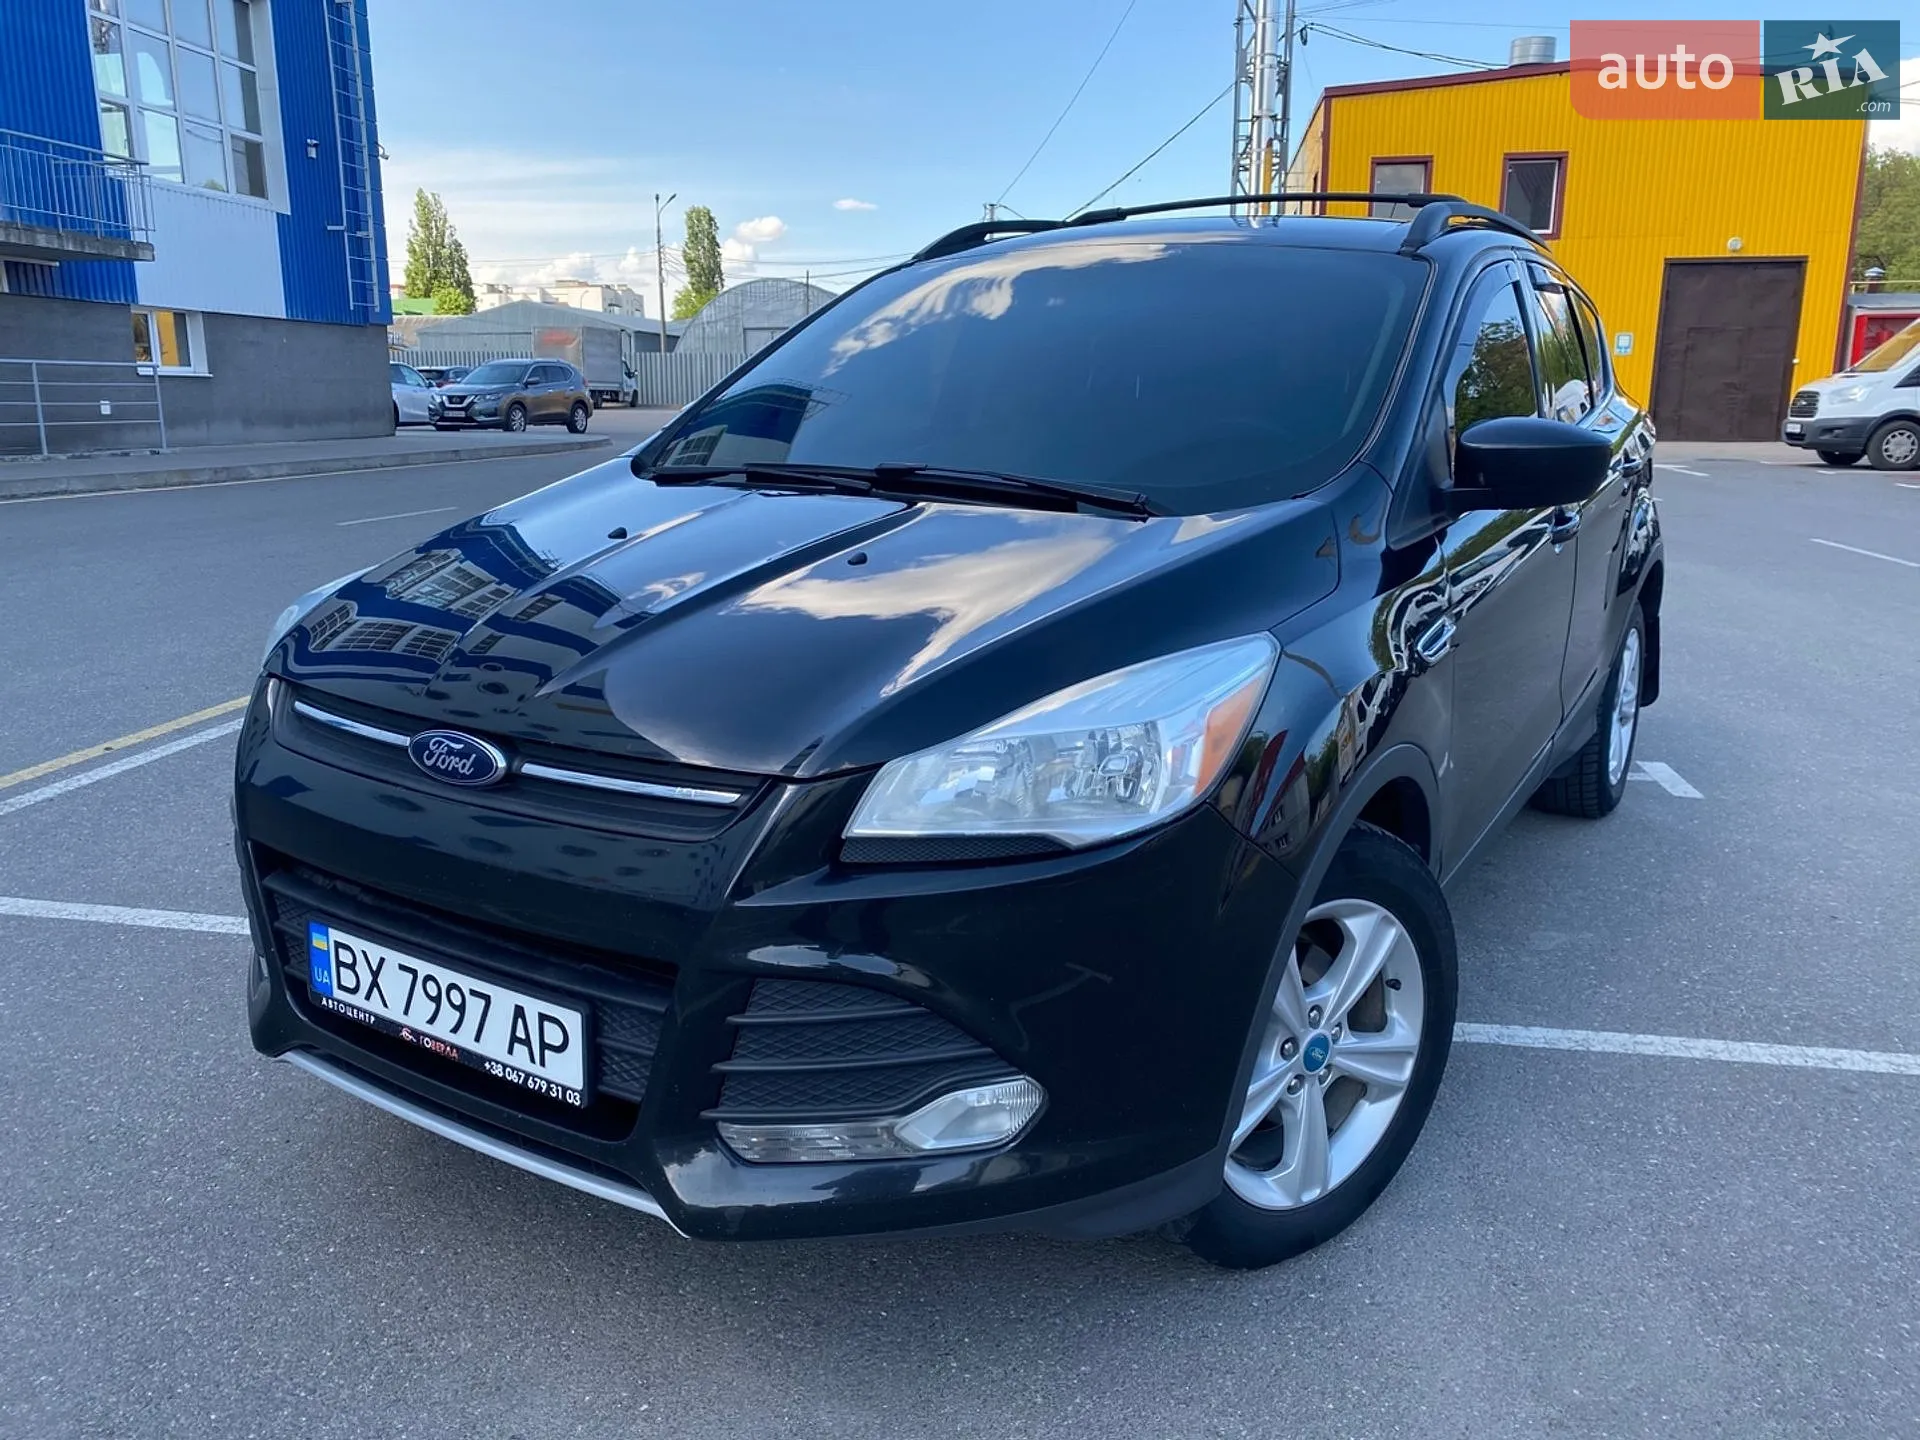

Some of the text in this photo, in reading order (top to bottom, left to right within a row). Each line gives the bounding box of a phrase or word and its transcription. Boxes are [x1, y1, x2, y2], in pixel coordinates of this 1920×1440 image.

[423, 737, 476, 775] Ford
[314, 966, 331, 985] UA
[321, 997, 376, 1024] АВТОЦЕНТР
[333, 940, 570, 1068] BX 7997 AP
[484, 1060, 581, 1106] +38 067 679 31 03
